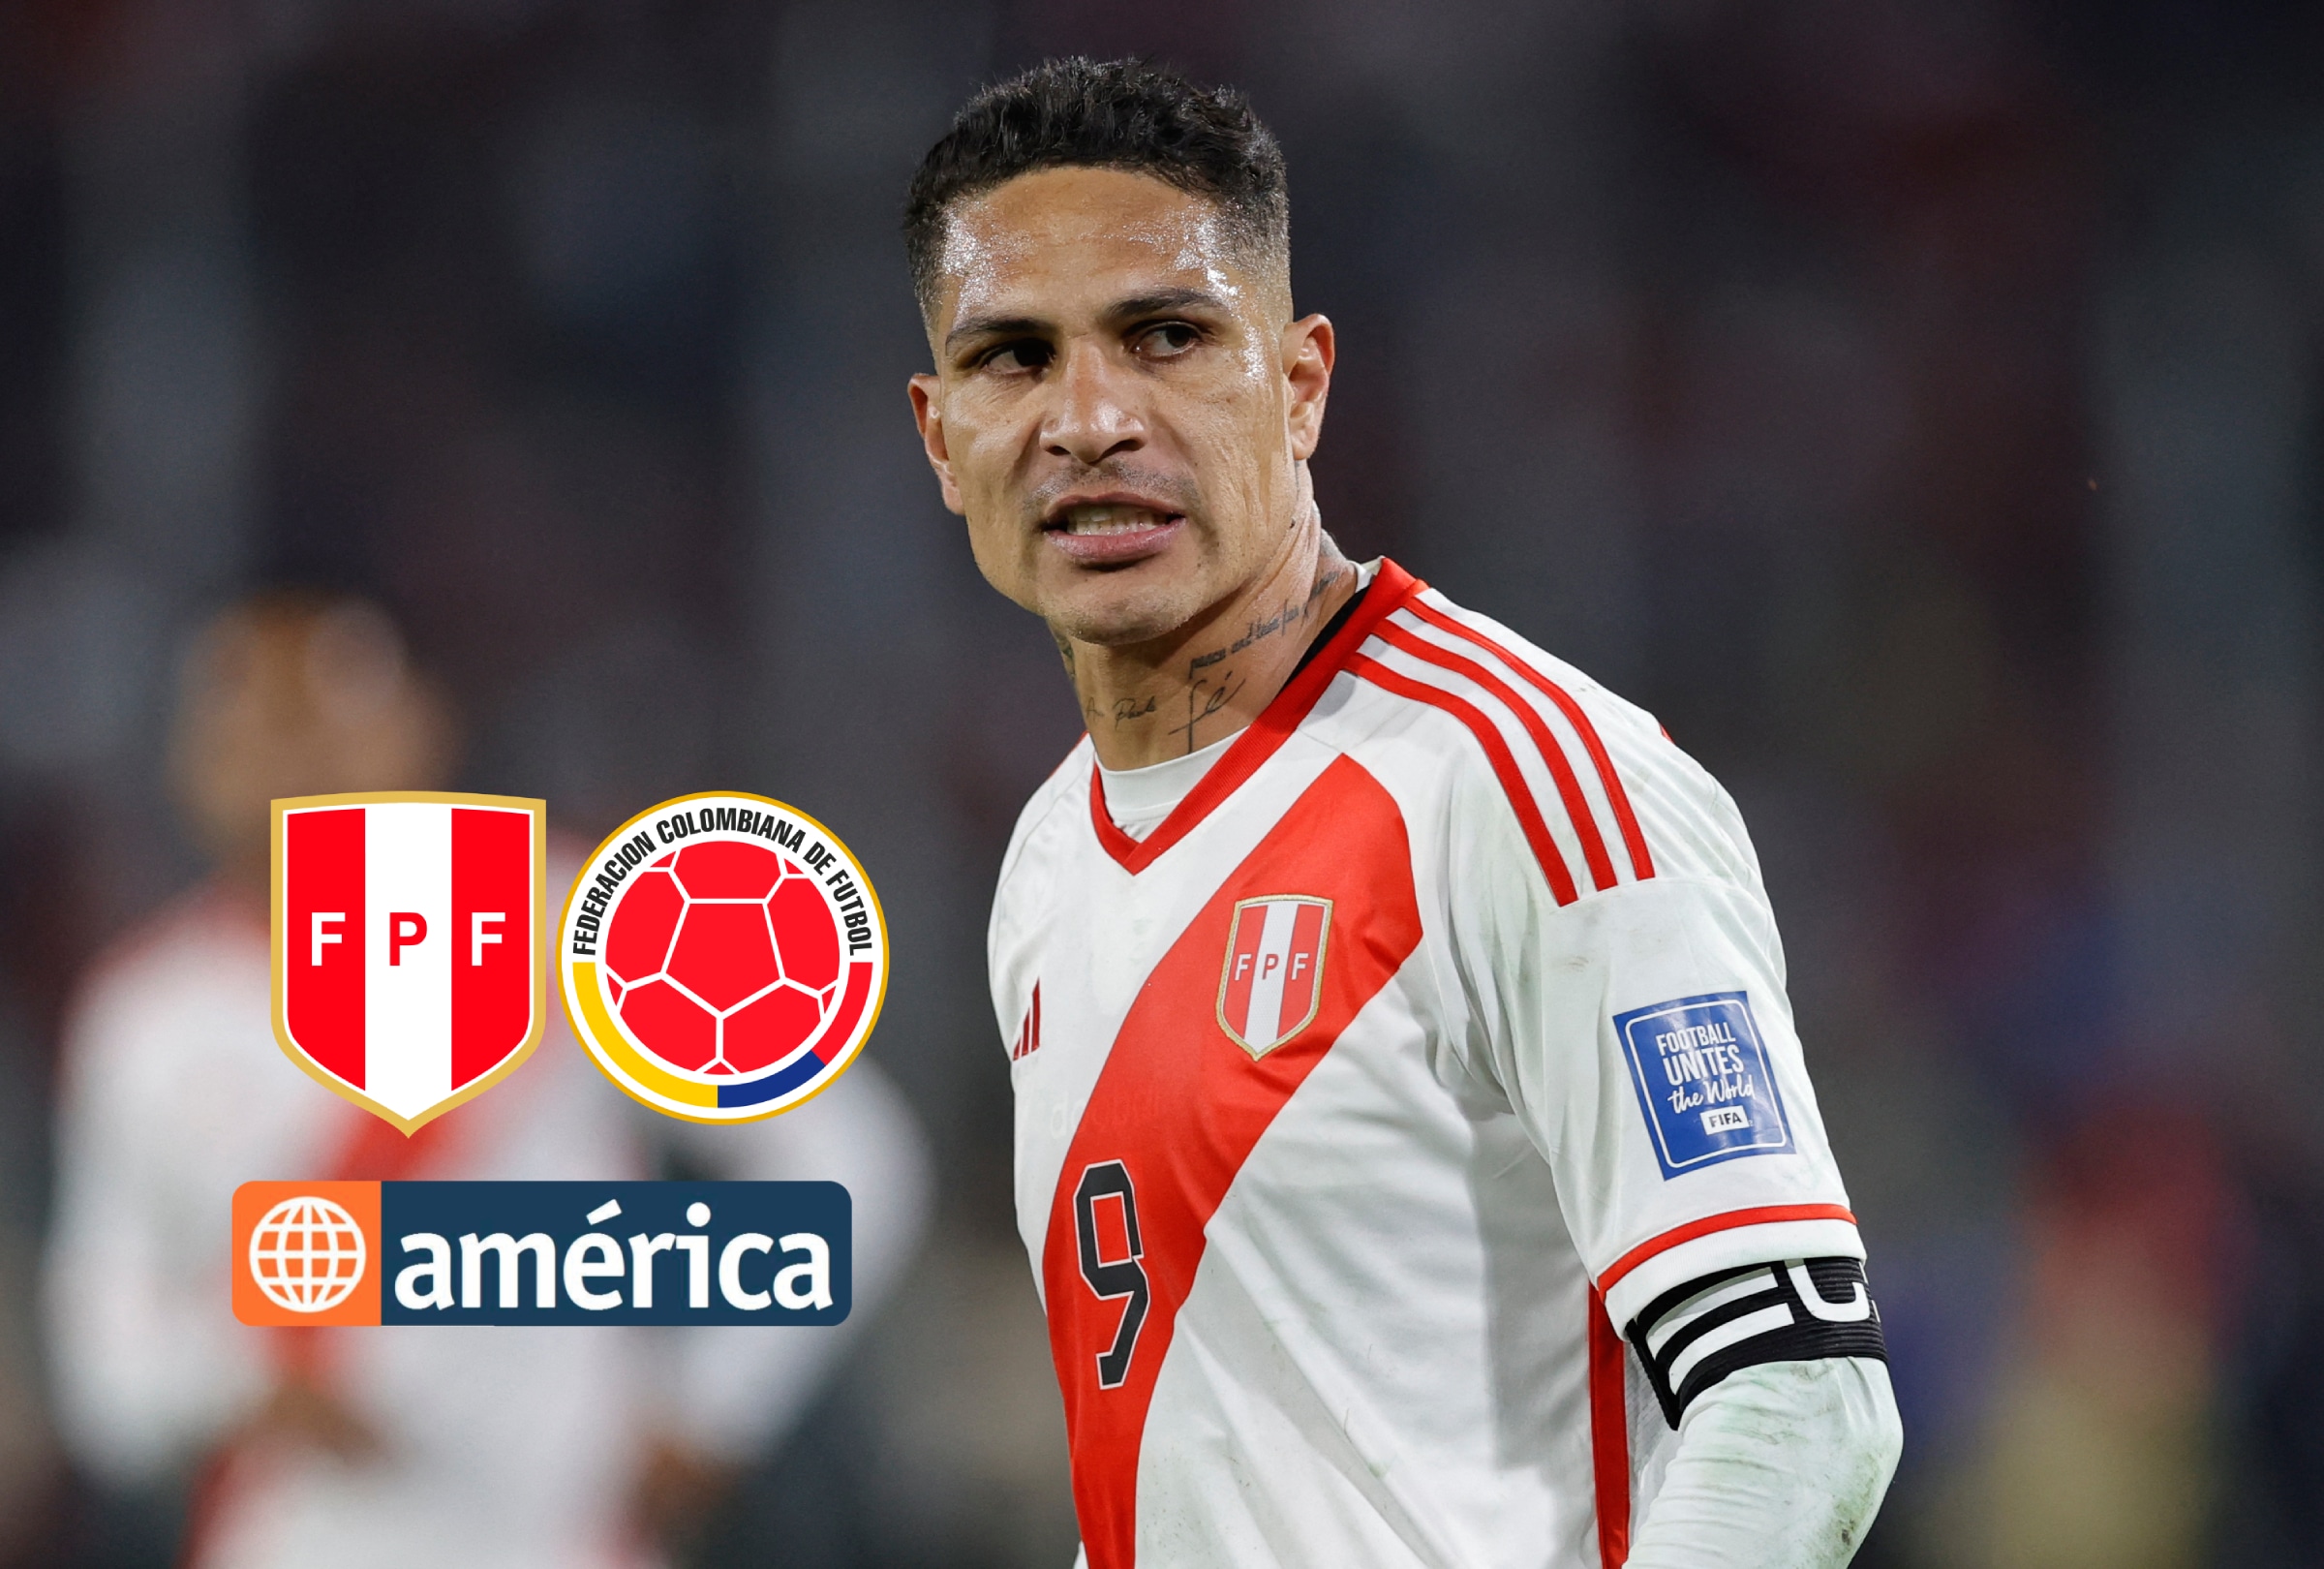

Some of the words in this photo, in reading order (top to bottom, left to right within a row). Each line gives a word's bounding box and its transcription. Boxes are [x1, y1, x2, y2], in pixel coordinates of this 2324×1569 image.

[1655, 1022, 1736, 1057] FOOTBALL
[1662, 1044, 1744, 1086] UNITES
[1667, 1086, 1704, 1114] the
[1703, 1073, 1757, 1104] World
[1708, 1112, 1742, 1128] FIFA
[1073, 1158, 1150, 1391] 9
